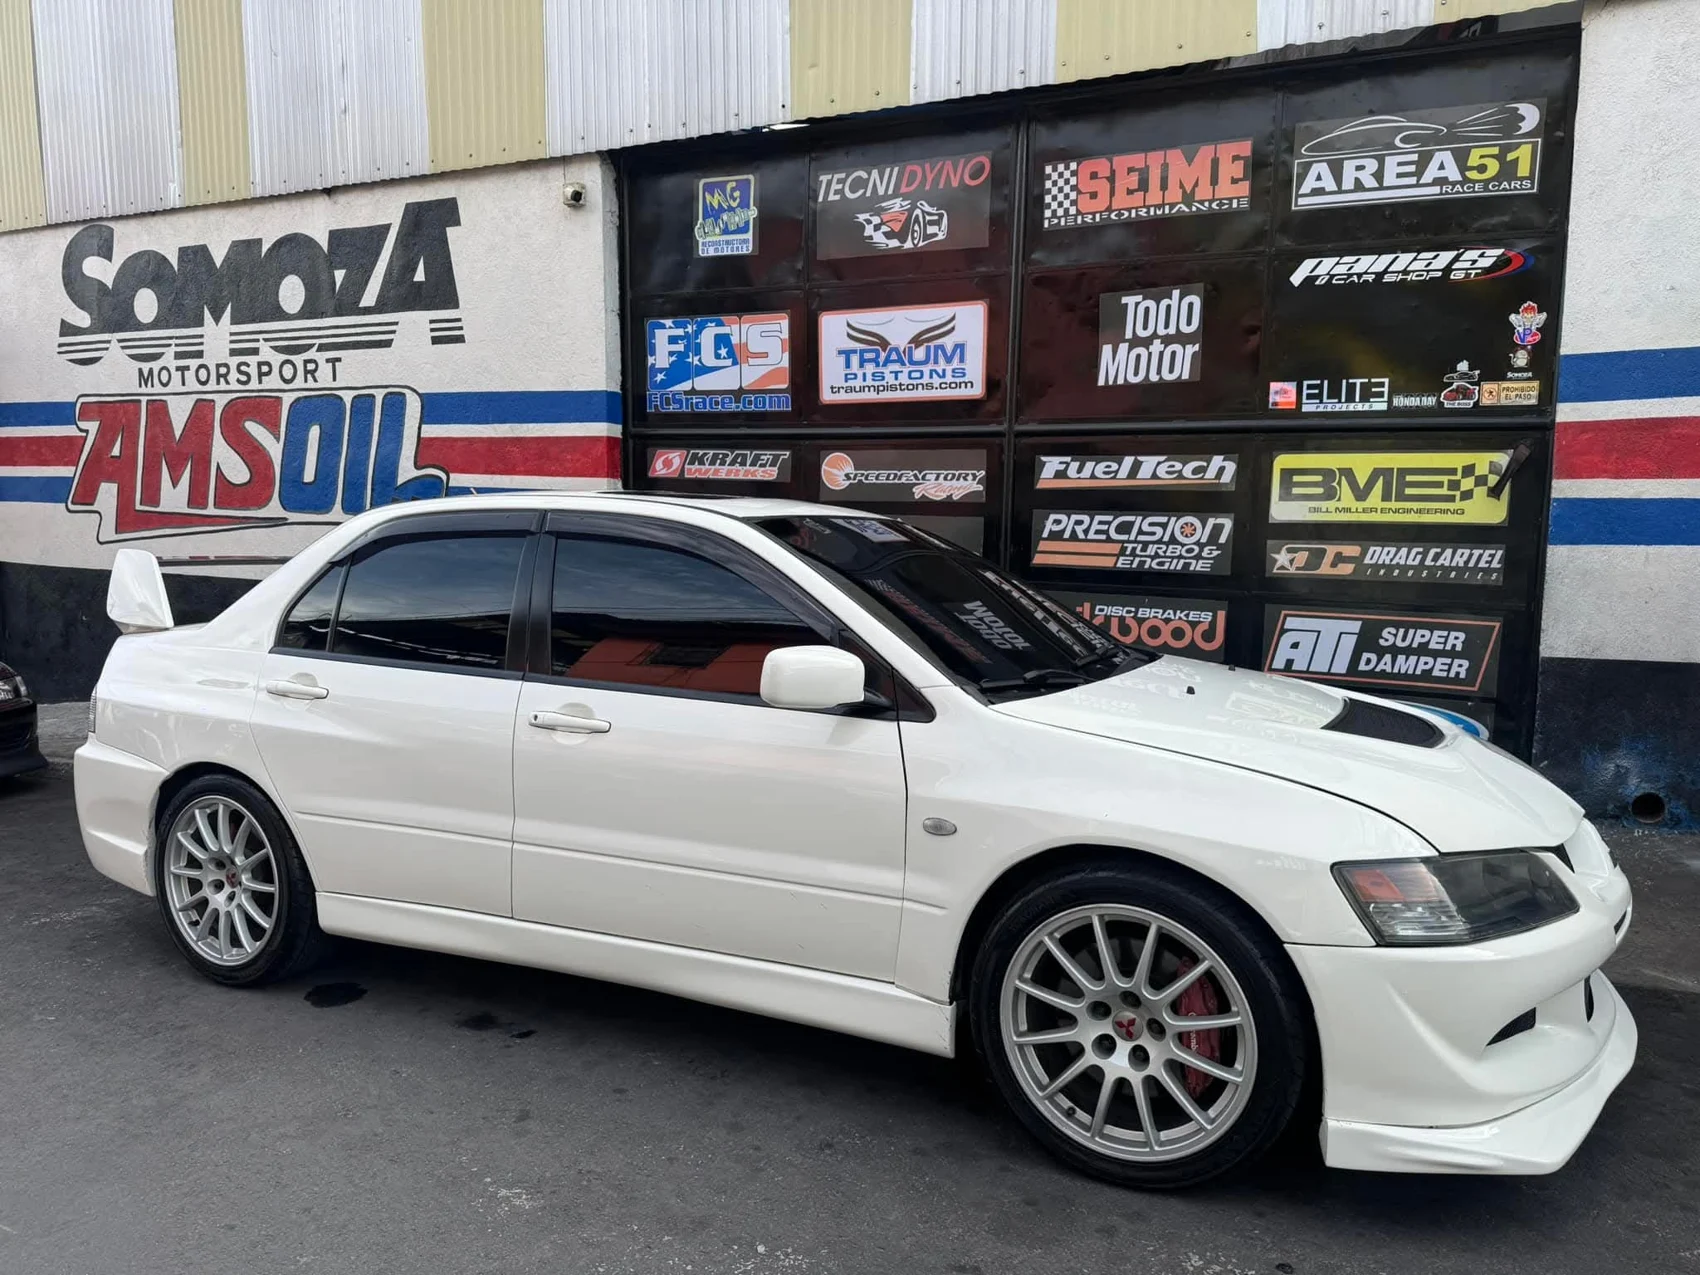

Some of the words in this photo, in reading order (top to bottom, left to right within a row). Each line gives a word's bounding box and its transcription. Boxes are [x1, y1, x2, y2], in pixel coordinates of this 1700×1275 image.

[1077, 142, 1250, 213] SEIME
[1442, 183, 1484, 194] RACE
[1488, 180, 1531, 191] CARS
[704, 181, 740, 215] MG
[1044, 199, 1249, 228] PERFORMANCE
[714, 245, 750, 253] MOTORES
[57, 197, 465, 365] SOMOZA
[1332, 274, 1374, 284] CAR
[1382, 271, 1442, 282] SHOP
[1450, 270, 1481, 280] GT
[1121, 290, 1200, 339] Todo
[654, 322, 784, 368] FCS
[836, 342, 966, 371] TRAUM
[1097, 341, 1199, 386] Motor
[138, 357, 342, 388] MOTORSPORT
[844, 367, 967, 383] PISTONS
[830, 379, 974, 395] traumpistons.com
[1502, 385, 1536, 393] PROHIBIDO
[646, 391, 791, 412] FCSrace.com
[1315, 403, 1374, 411] PROJECTS
[71, 391, 446, 534] AMSOIL
[686, 450, 790, 468] KRAFT
[1040, 454, 1238, 484] FuelTech
[685, 466, 778, 479] WERKS
[842, 470, 985, 485] SPEEDFACTORY
[1278, 467, 1459, 503] BME
[1308, 506, 1333, 514] BILL
[1380, 507, 1465, 515] ENGINEERING
[1042, 515, 1232, 545] PRECISION
[1122, 543, 1200, 557] TURBO
[1202, 545, 1221, 558] &
[1363, 546, 1423, 566] DRAG
[1424, 547, 1504, 568] CARTEL
[1117, 556, 1212, 571] ENGINE
[1366, 568, 1499, 580] INDUSTRIES
[1095, 605, 1135, 617] DISC
[1137, 608, 1213, 622] BRAKES
[1378, 626, 1465, 651] SUPER
[1358, 652, 1469, 678] DAMPER
